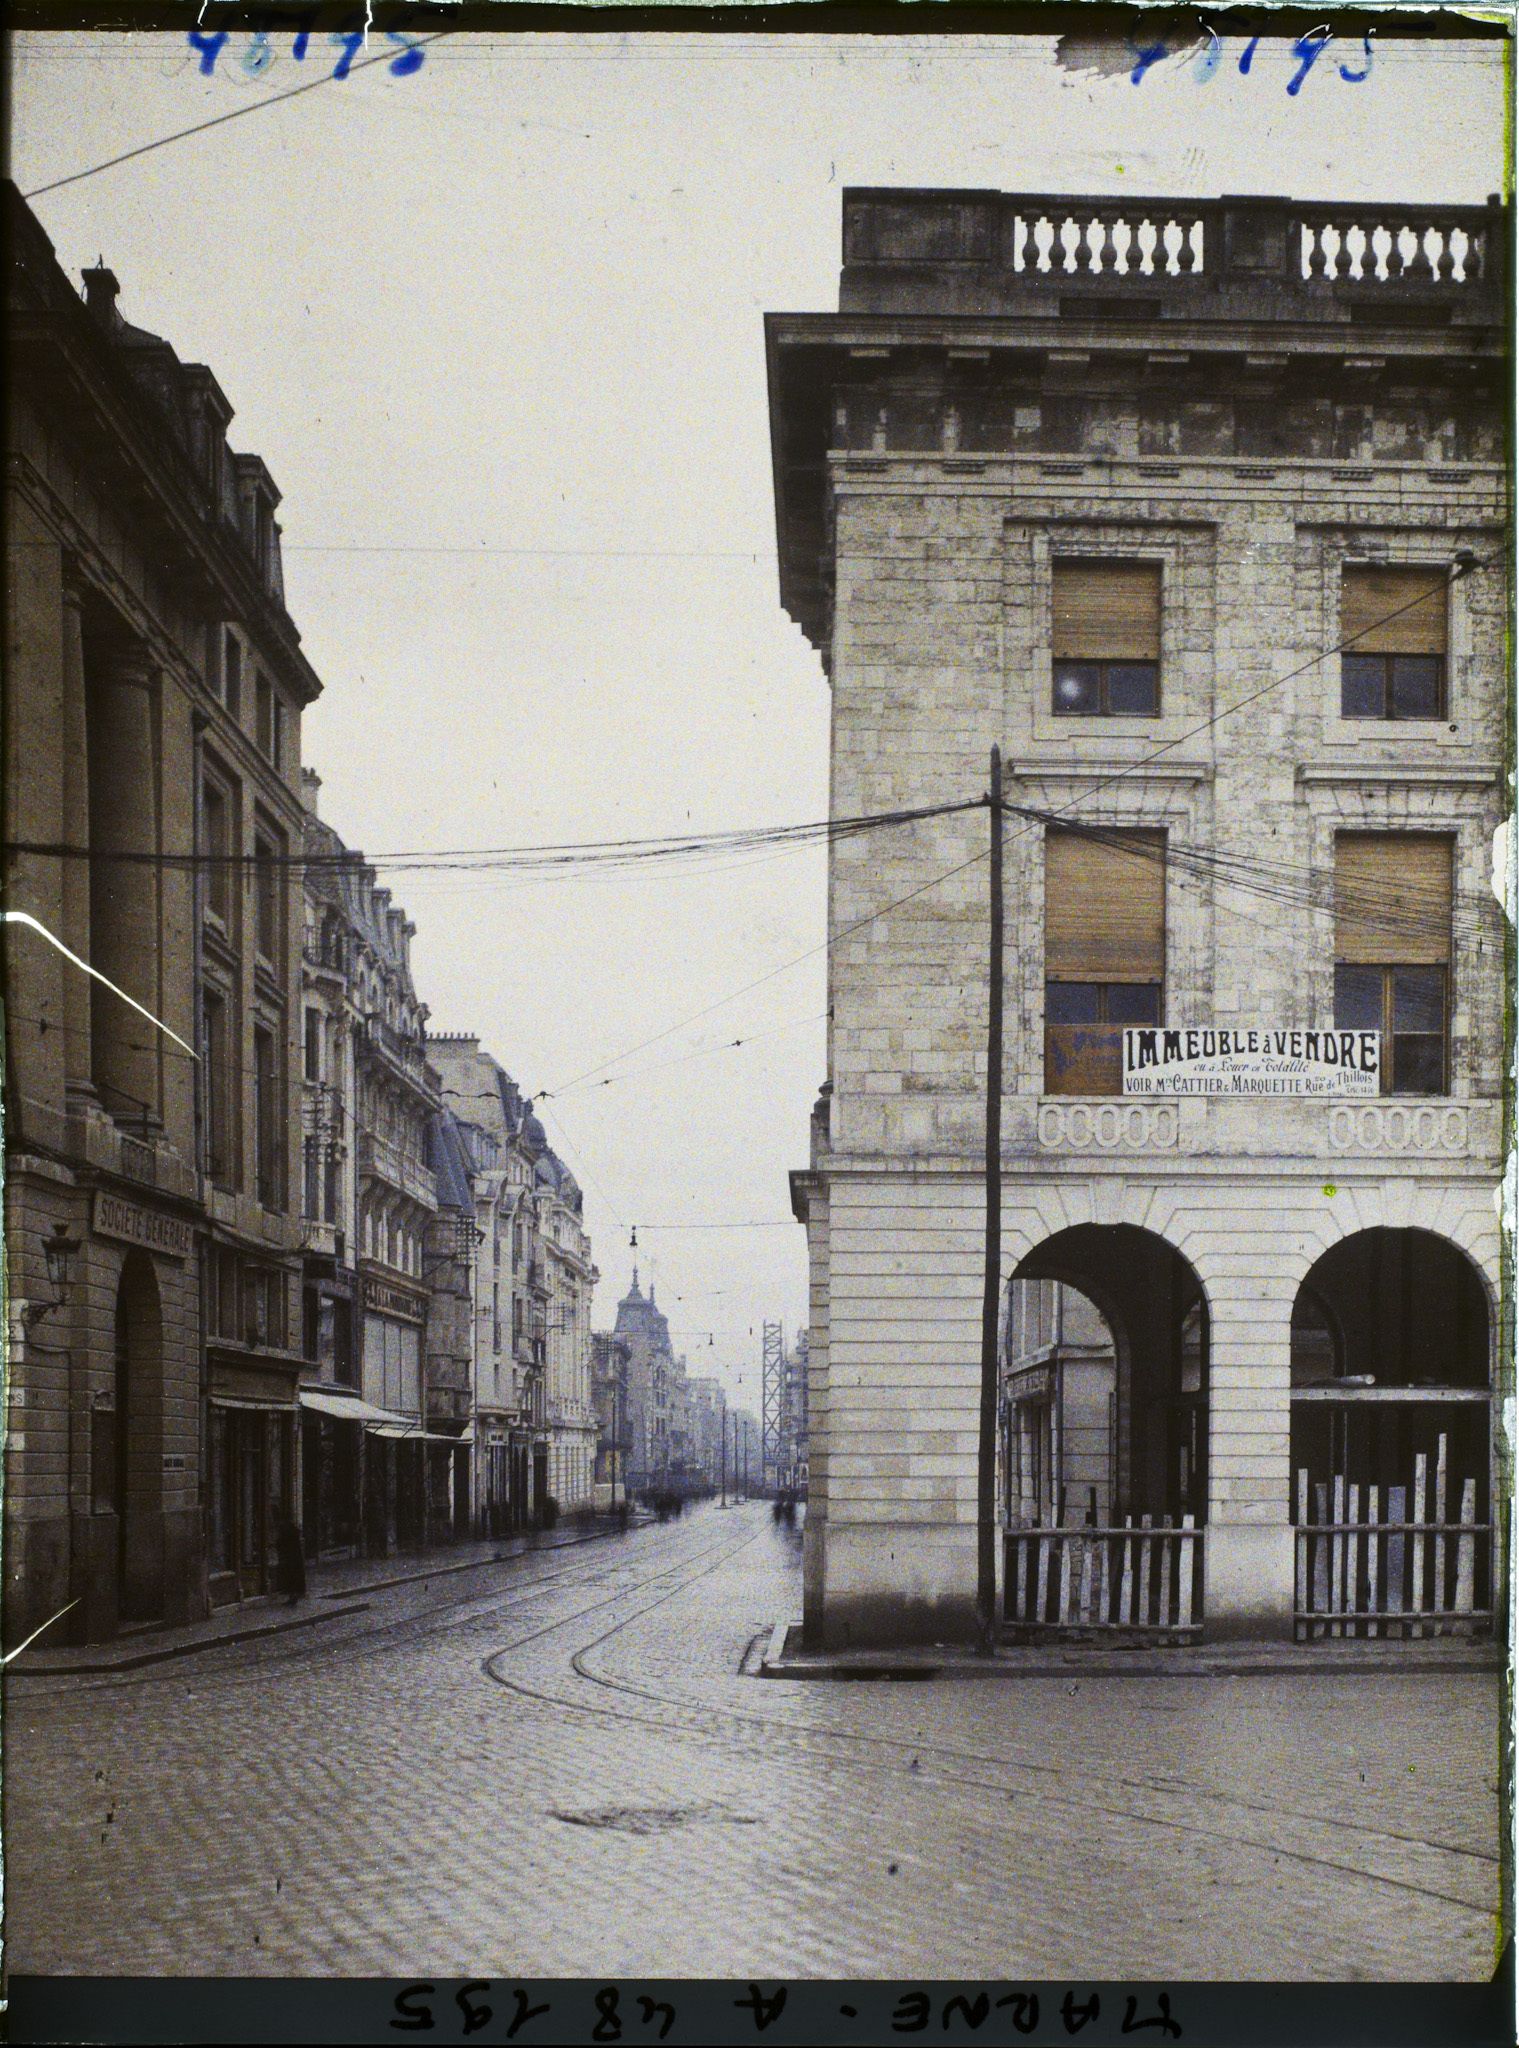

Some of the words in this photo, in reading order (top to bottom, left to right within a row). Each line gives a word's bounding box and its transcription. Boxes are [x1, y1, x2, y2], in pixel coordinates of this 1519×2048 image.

[1126, 1030, 1259, 1071] IMMEUBLE
[1262, 1034, 1271, 1054] à
[1273, 1031, 1378, 1073] VENDRE
[1194, 1063, 1206, 1071] ou
[1218, 1056, 1249, 1072] Louer
[1126, 1078, 1152, 1092] VOIR
[1173, 1073, 1223, 1093] CATTIER
[1231, 1074, 1302, 1094] MARQUETTE
[1305, 1078, 1324, 1094] Rue
[1336, 1070, 1373, 1086] Thillois
[733, 1984, 788, 2033] A
[892, 1988, 1182, 2039] MARNE
